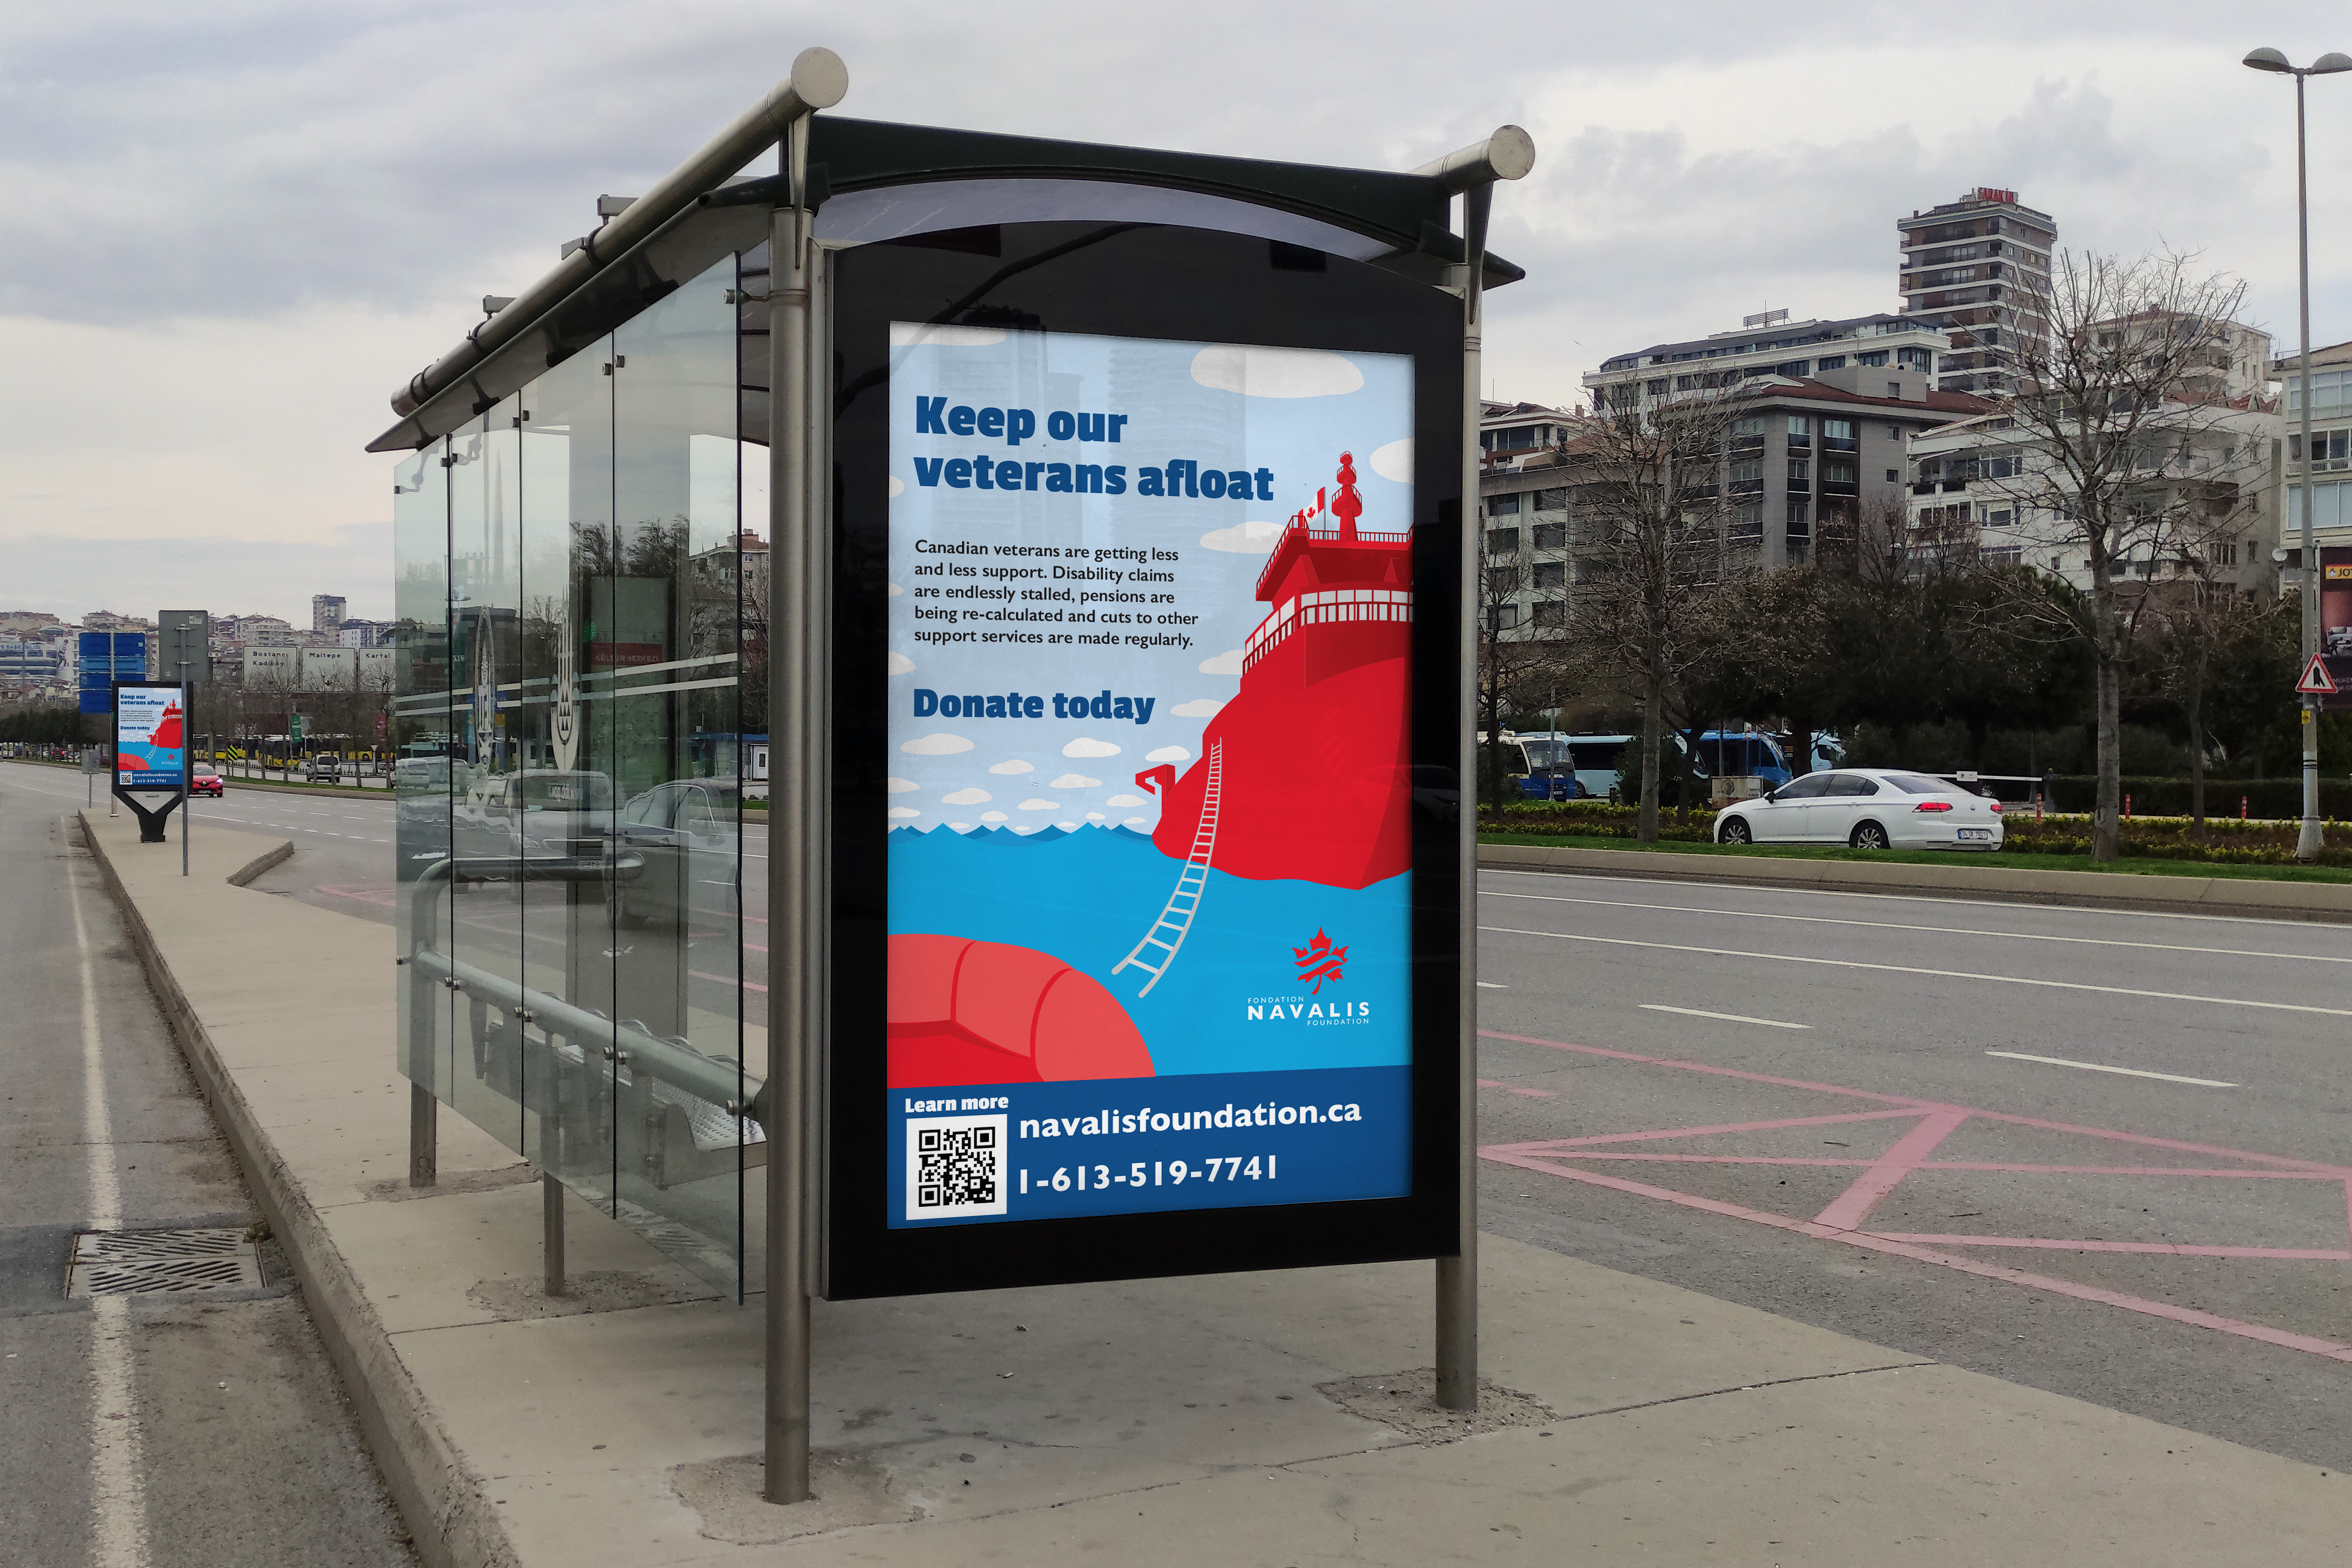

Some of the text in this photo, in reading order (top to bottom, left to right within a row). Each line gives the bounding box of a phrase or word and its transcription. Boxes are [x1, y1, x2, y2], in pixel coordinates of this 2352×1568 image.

[916, 395, 1128, 446] Keep our
[913, 455, 1274, 501] veterans afloat
[915, 539, 1179, 564] Canadian veterans are getting less
[915, 562, 1174, 584] and less support. Disability claims
[915, 585, 1174, 605] are endlessly stalled, pensions are
[915, 605, 1199, 625] being re-calculated and cuts to other
[914, 630, 1193, 650] support services are made regularly.
[914, 688, 1156, 725] Donate today
[1248, 1001, 1369, 1020] NAVALIS
[905, 1097, 1009, 1113] Learn more
[1020, 1101, 1362, 1138] navalisfoundation.ca
[1020, 1155, 1276, 1194] 1-613-519-7741
